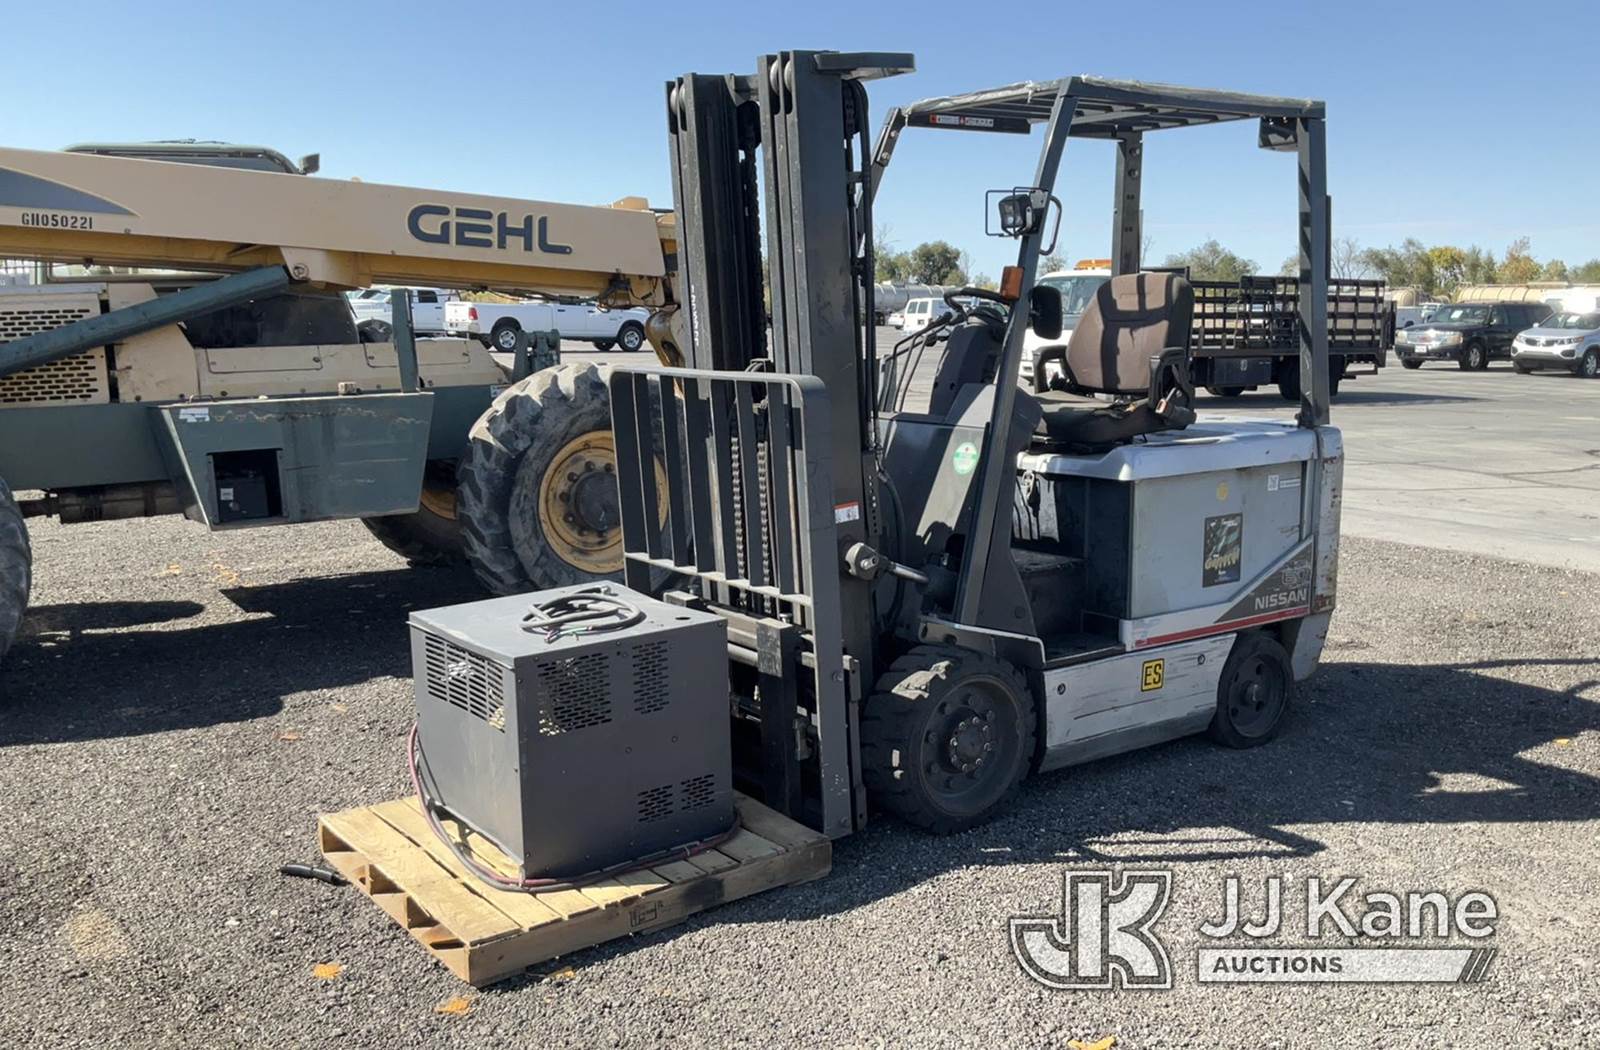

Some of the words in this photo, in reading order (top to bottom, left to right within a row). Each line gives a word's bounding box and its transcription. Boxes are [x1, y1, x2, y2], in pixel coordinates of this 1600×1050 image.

[407, 203, 573, 255] GEHL
[1254, 588, 1308, 611] NISSAN
[1144, 663, 1162, 686] ES
